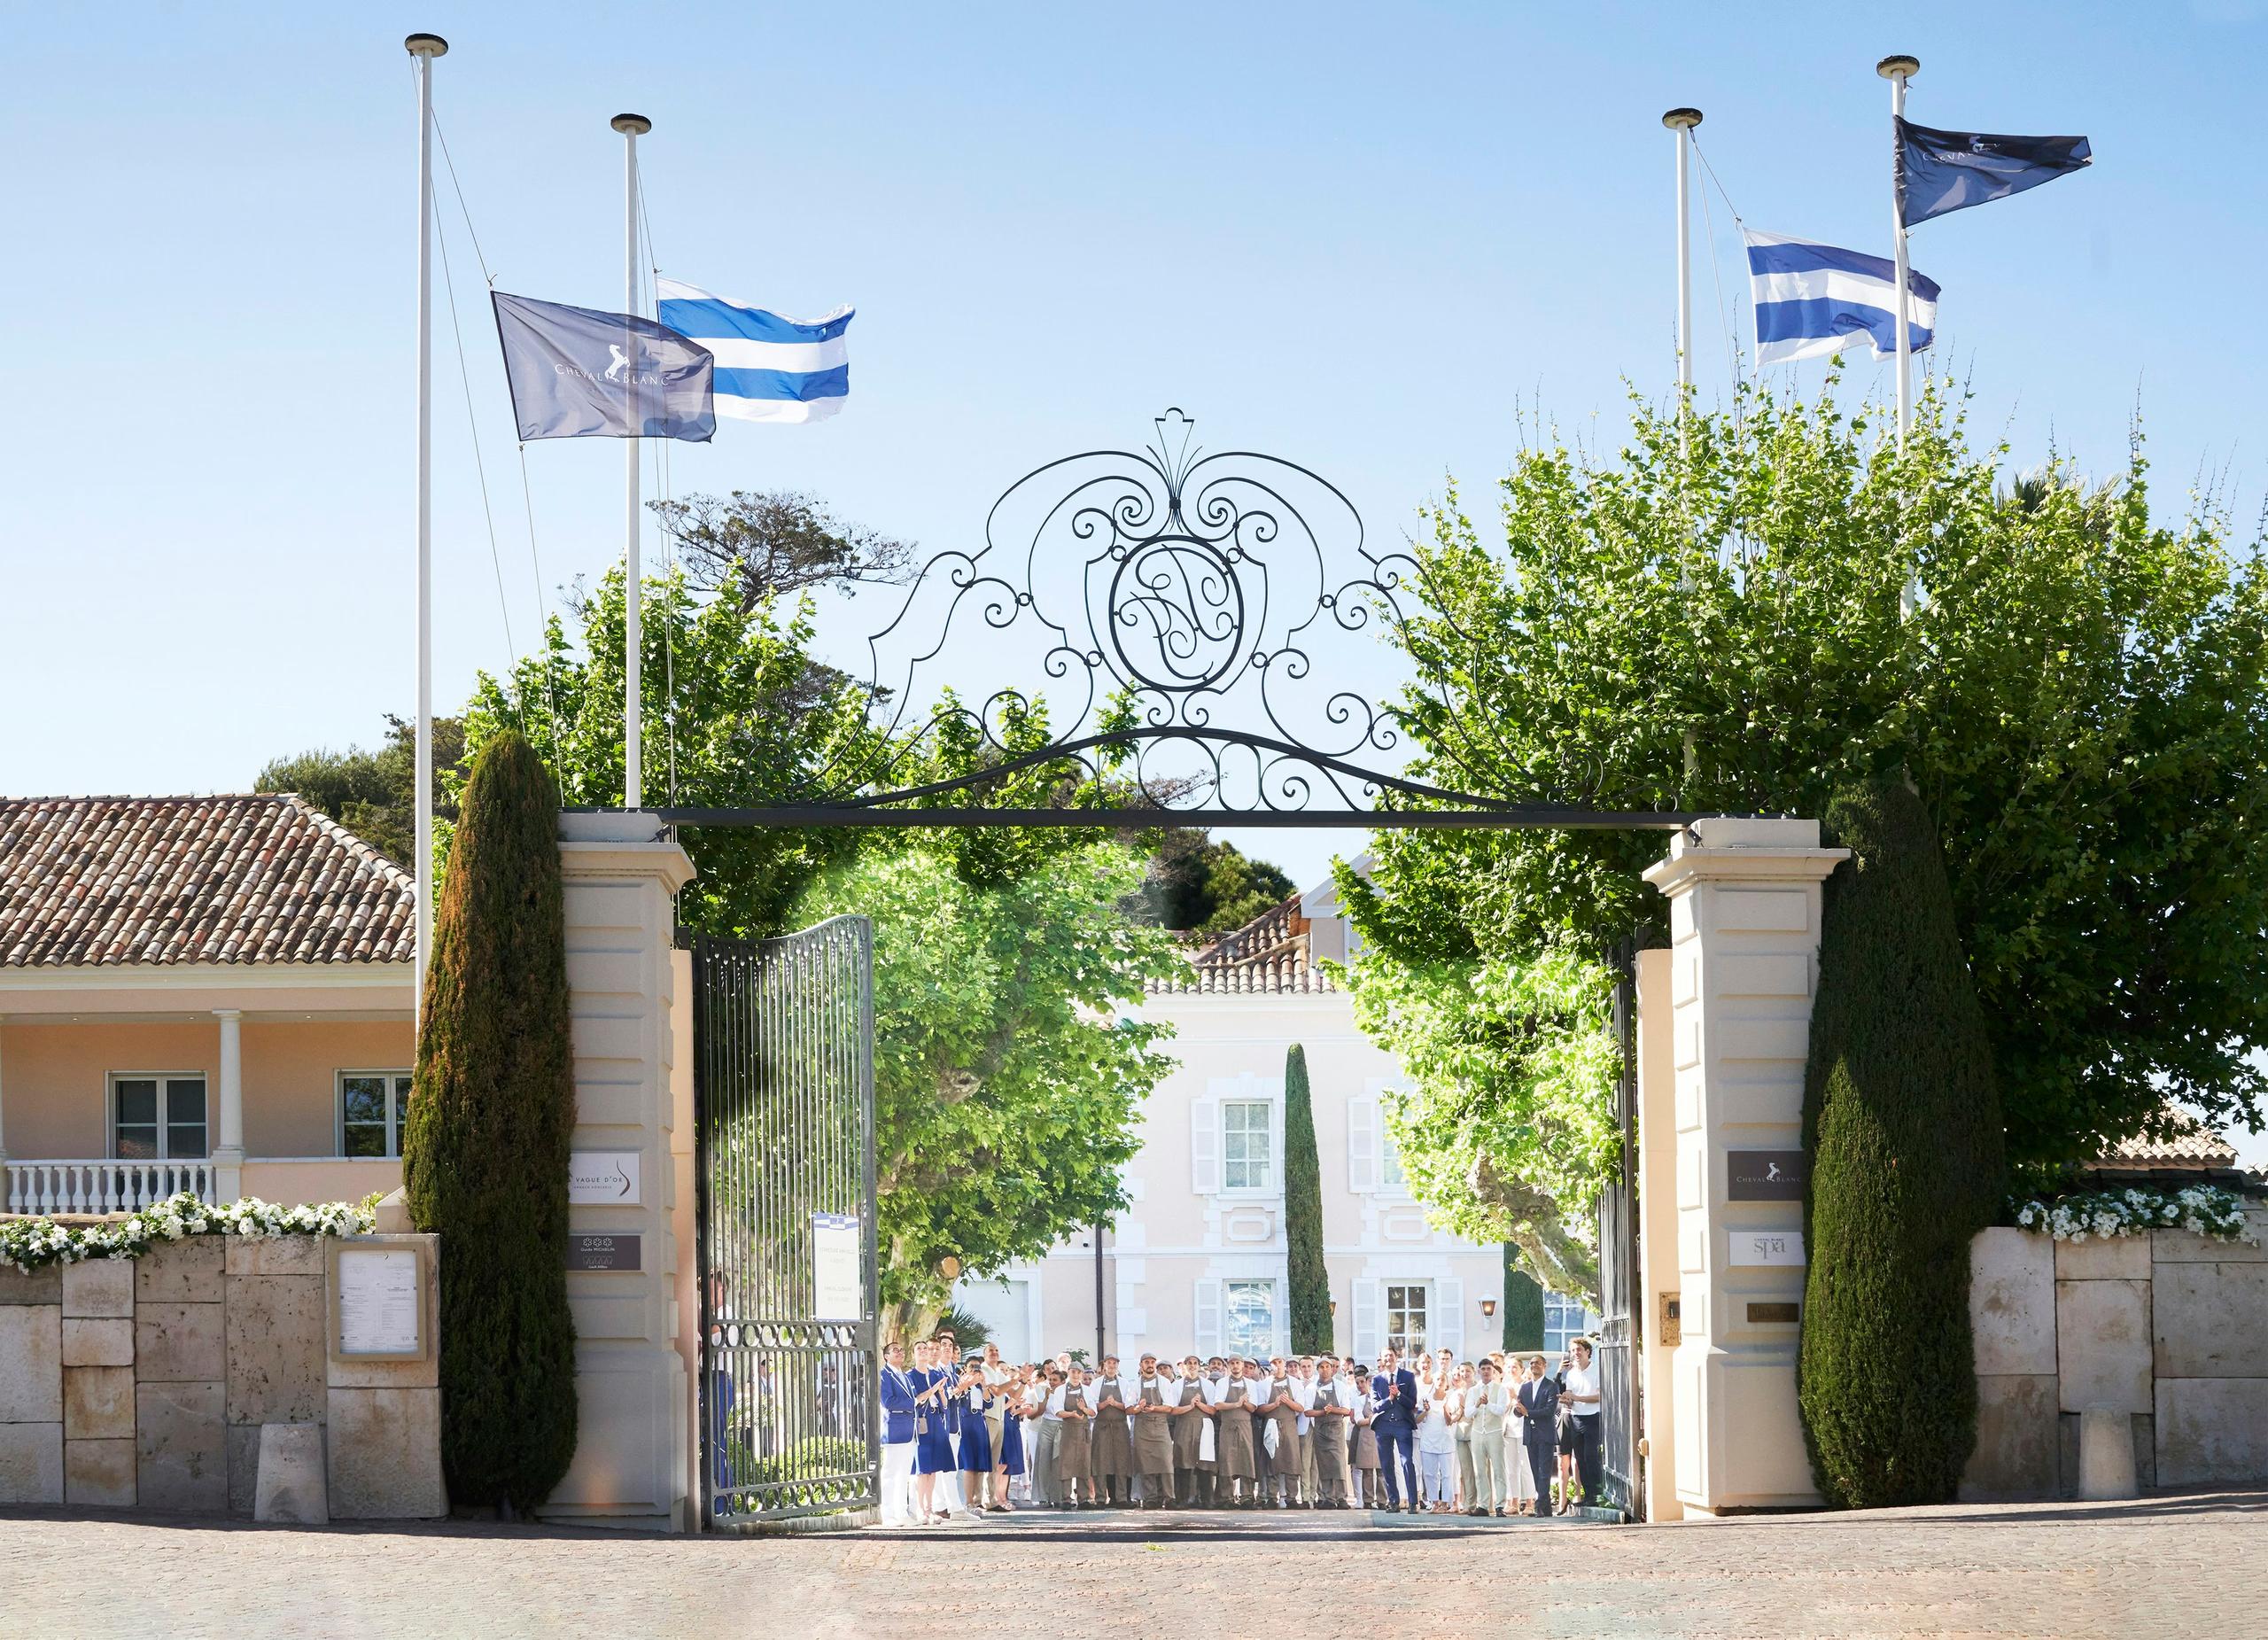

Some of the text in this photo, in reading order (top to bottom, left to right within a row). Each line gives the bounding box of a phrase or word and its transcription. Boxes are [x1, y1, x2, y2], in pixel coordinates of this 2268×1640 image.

[555, 363, 669, 386] CHEVAL BLANC
[1754, 1241, 1786, 1260] spa
